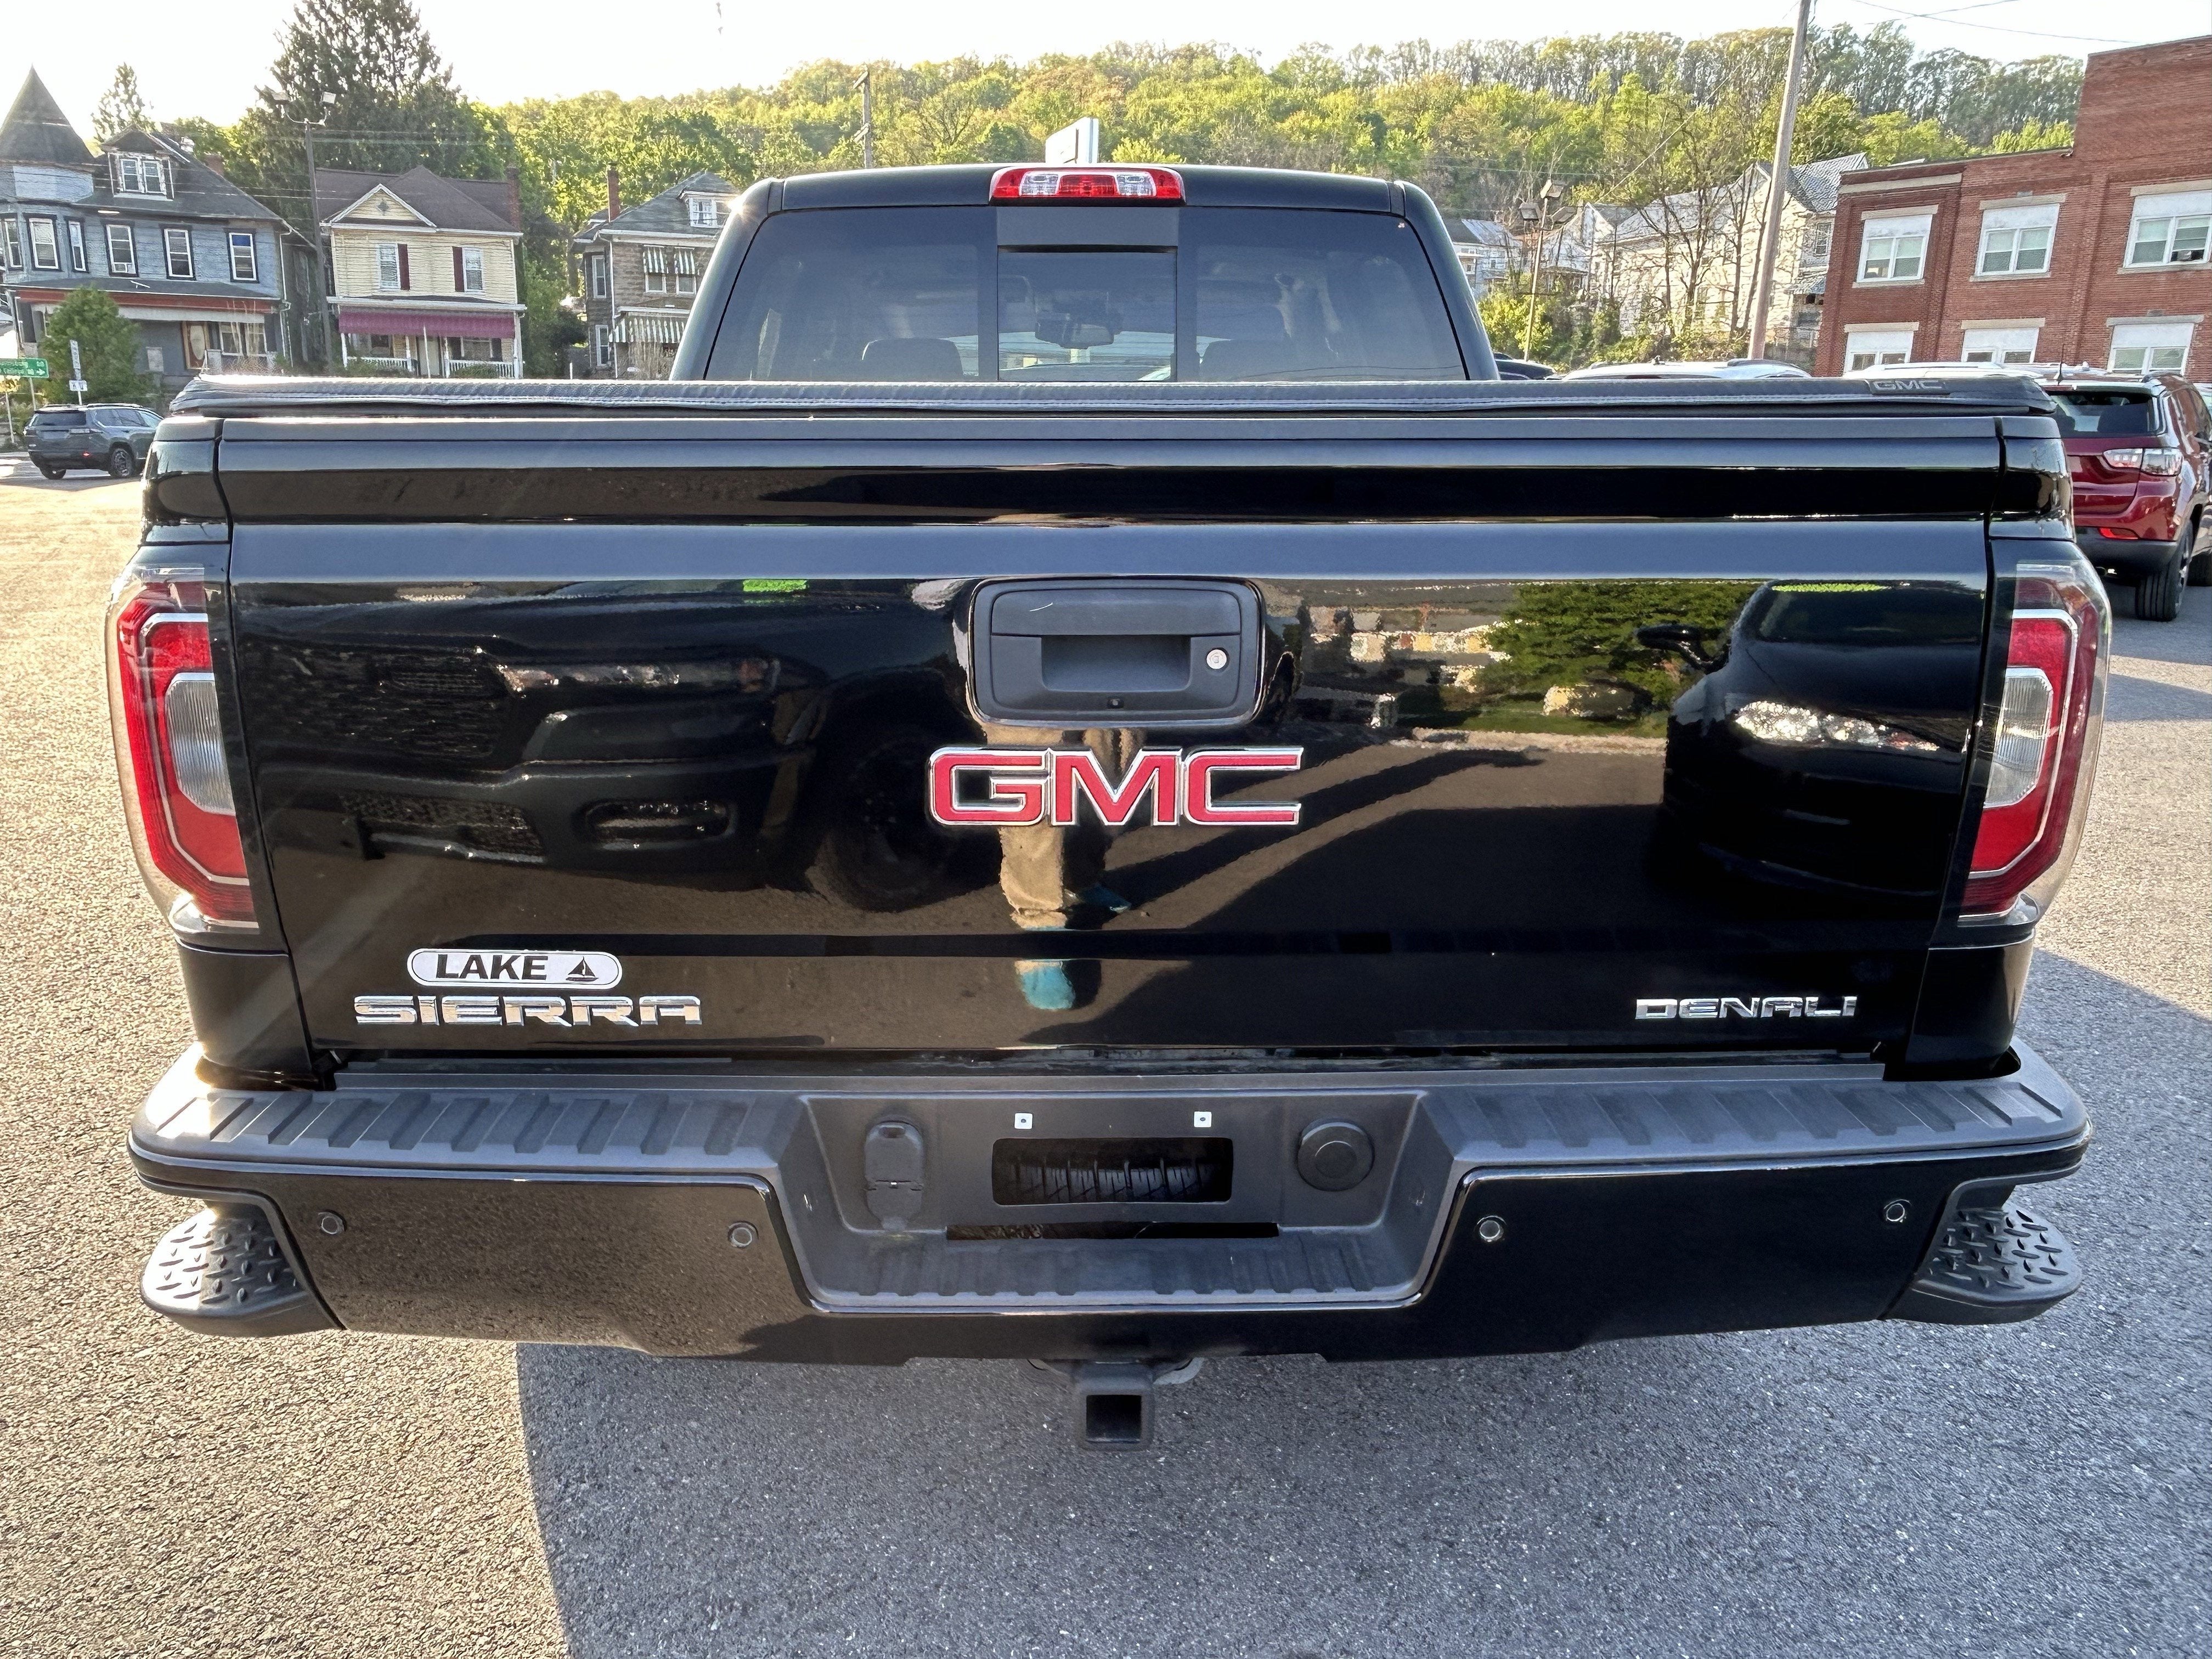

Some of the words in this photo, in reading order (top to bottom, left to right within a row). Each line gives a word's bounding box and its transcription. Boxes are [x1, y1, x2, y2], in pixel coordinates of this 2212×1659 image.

[1872, 379, 1943, 390] GMC
[928, 747, 1304, 826] GMC
[436, 953, 549, 981] LAKE
[354, 995, 702, 1026] SIERRA
[1635, 996, 1858, 1020] DENALI
